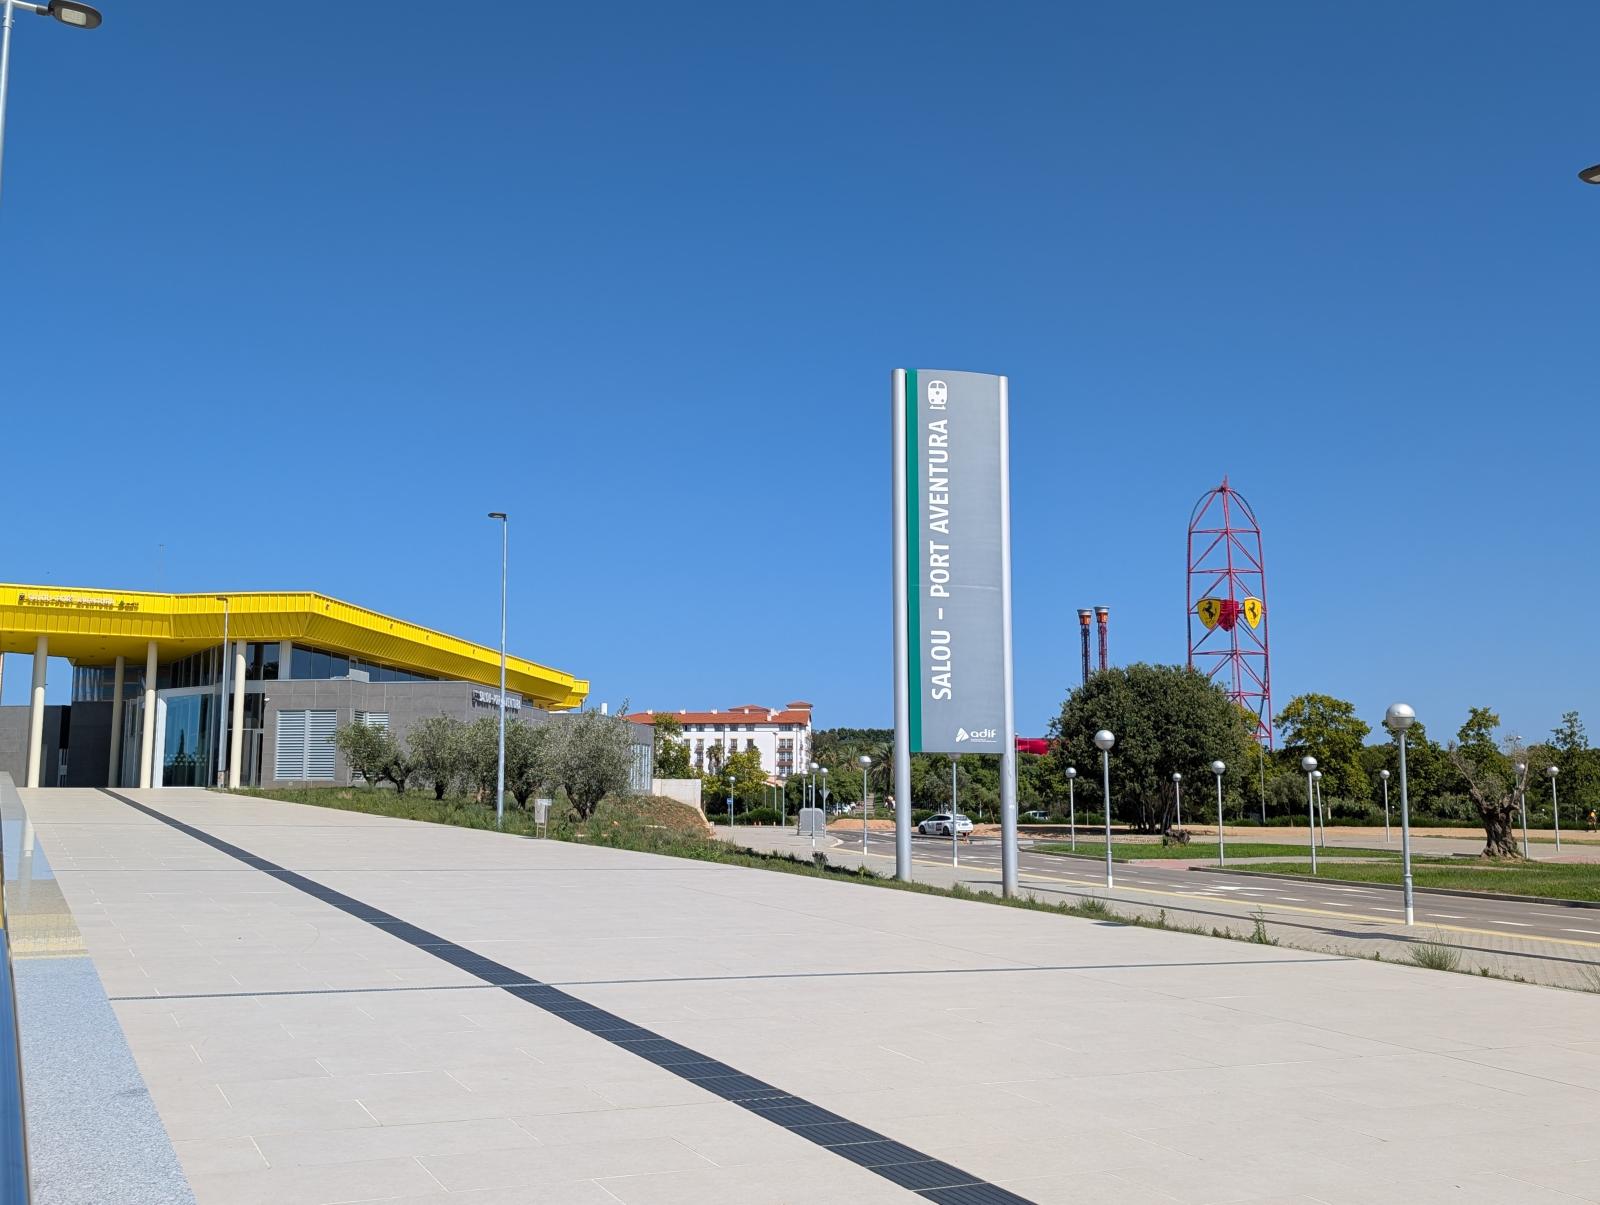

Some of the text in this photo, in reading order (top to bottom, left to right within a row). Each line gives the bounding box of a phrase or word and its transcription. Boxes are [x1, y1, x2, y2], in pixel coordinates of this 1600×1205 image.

[928, 419, 949, 534] AVENTURA
[929, 540, 950, 598] PORT
[930, 630, 952, 700] SALOU
[970, 728, 997, 738] adif
